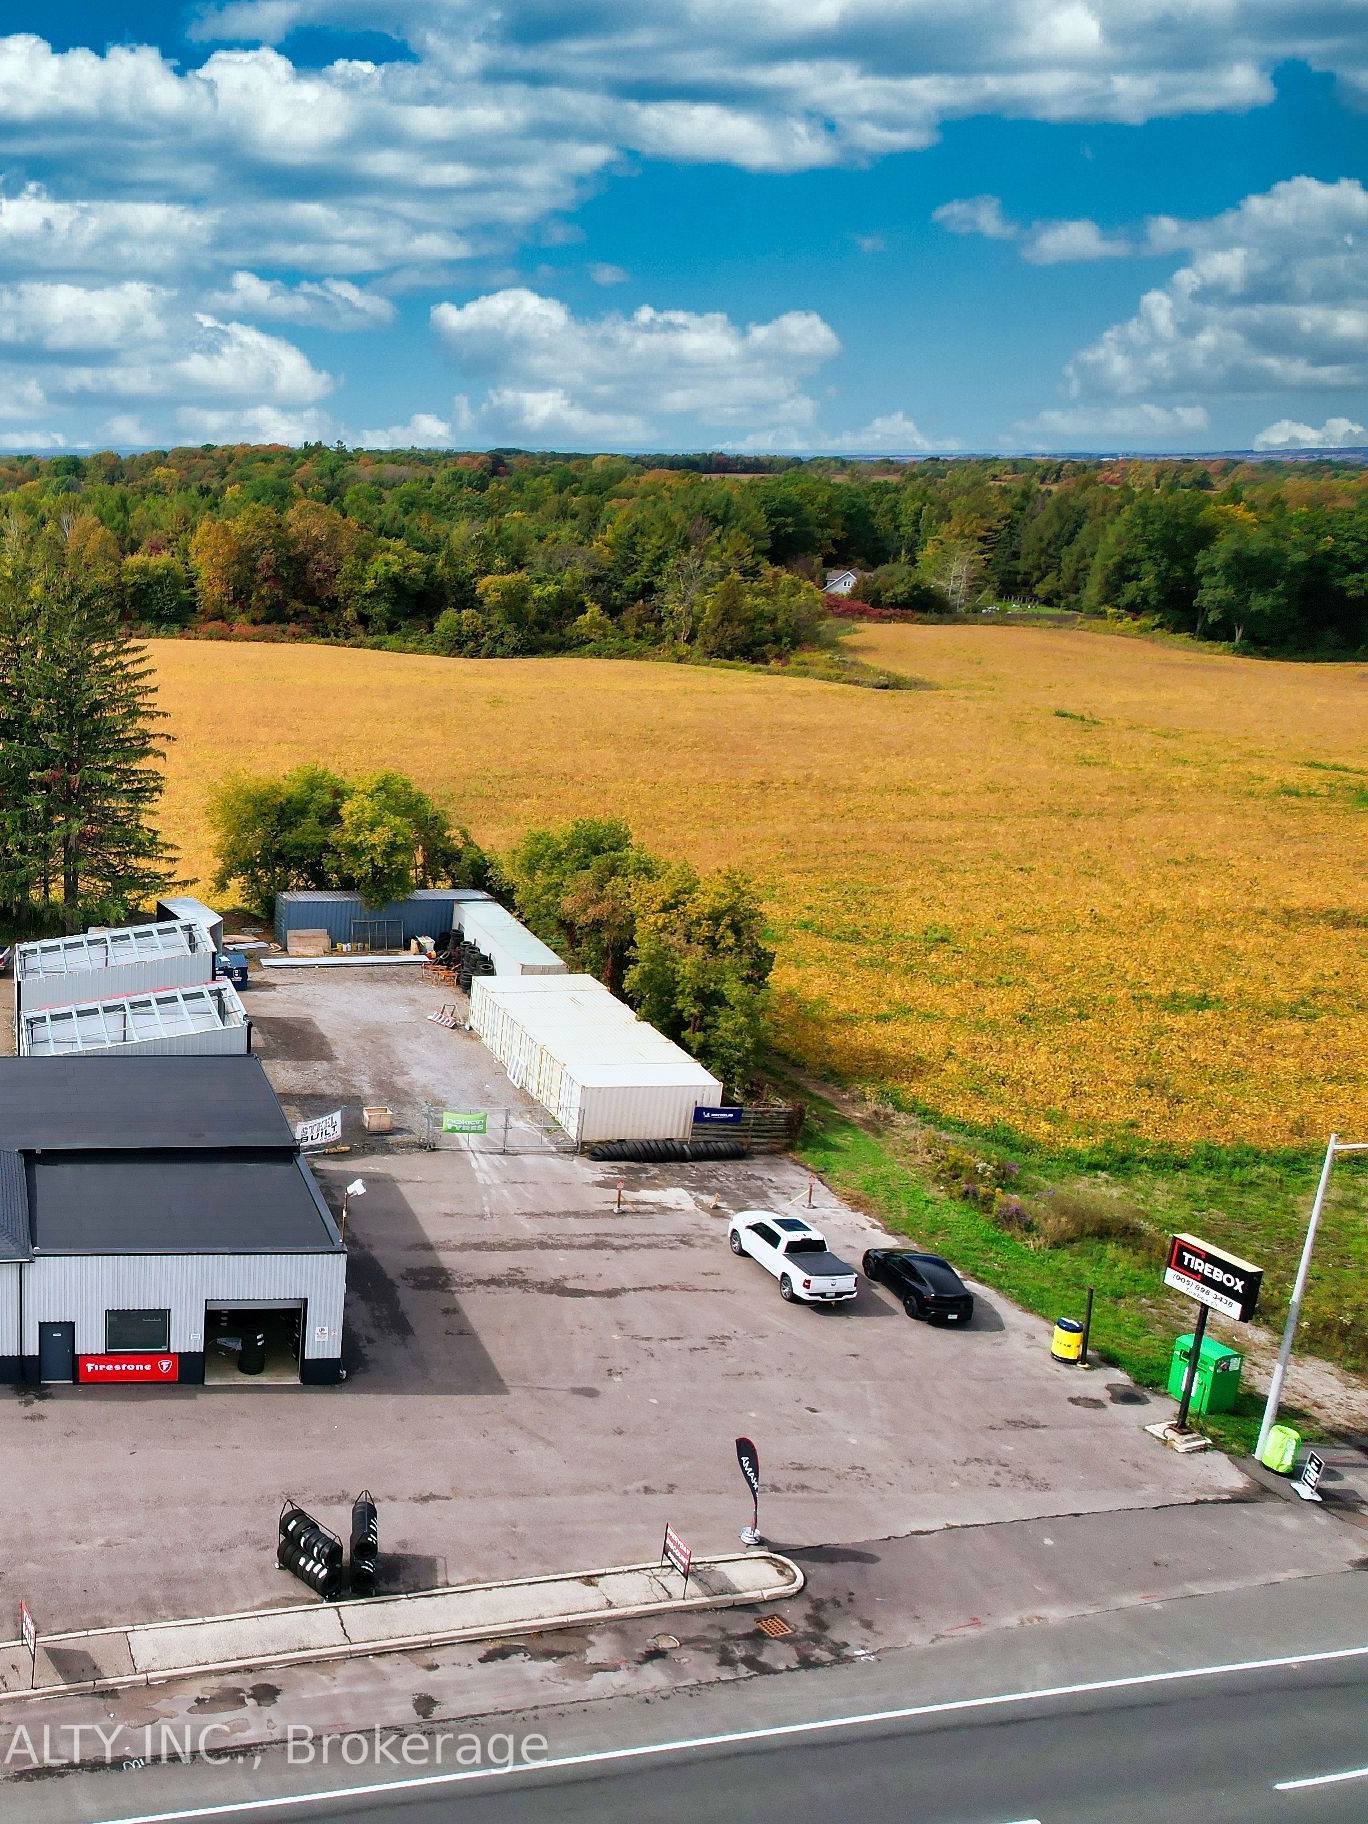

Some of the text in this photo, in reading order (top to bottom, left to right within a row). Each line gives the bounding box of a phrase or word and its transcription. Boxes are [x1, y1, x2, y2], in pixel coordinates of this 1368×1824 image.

[301, 1124, 338, 1143] BUILT
[1182, 1251, 1245, 1294] TIREBOX
[86, 1363, 152, 1372] Firestone
